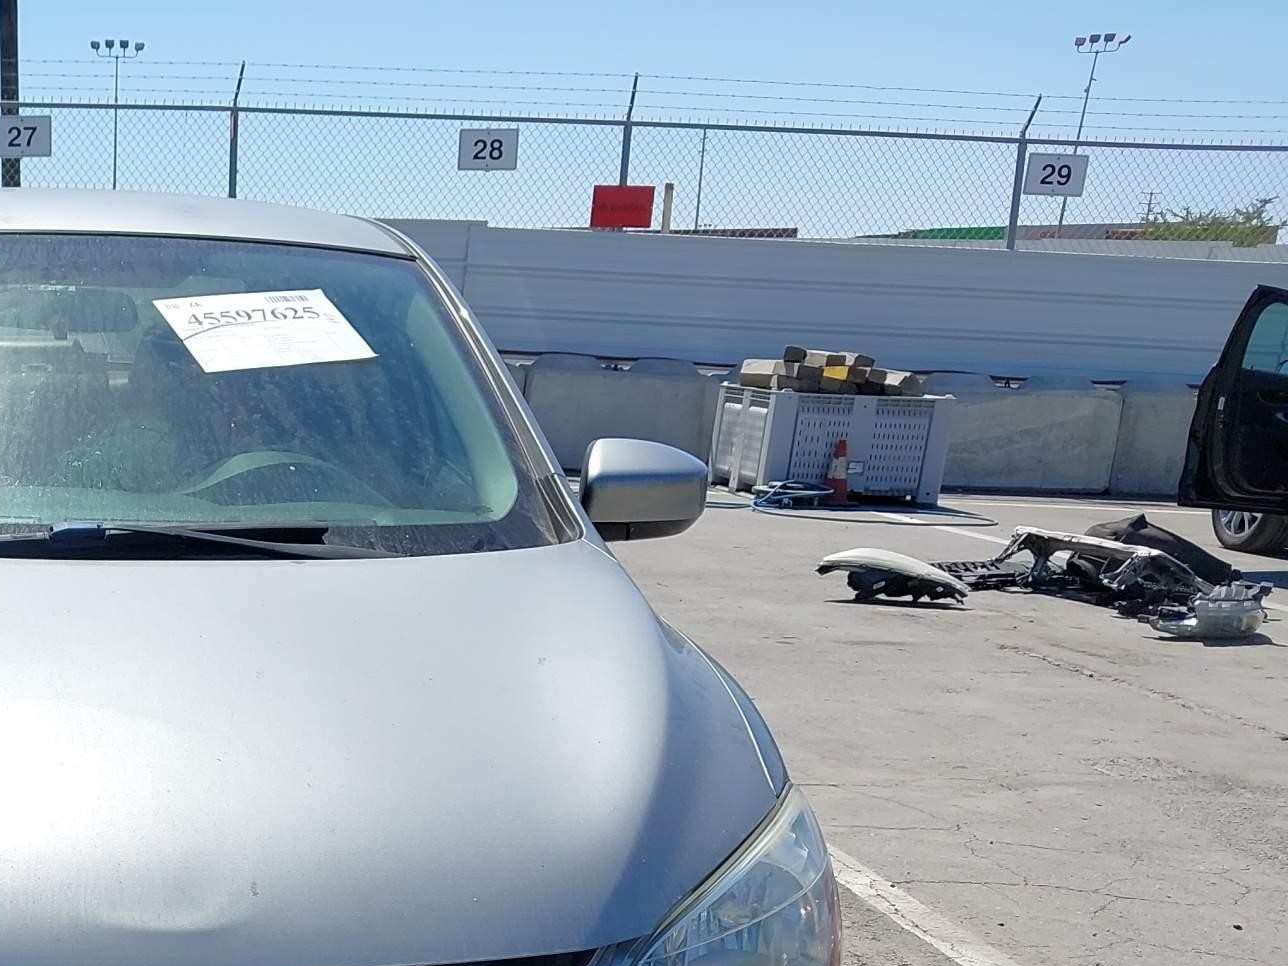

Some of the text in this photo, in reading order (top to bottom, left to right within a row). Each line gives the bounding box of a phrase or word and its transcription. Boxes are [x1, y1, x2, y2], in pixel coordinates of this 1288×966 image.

[7, 126, 38, 148] 27
[472, 138, 504, 161] 28
[1039, 164, 1072, 187] 29
[187, 306, 320, 327] 45597625
